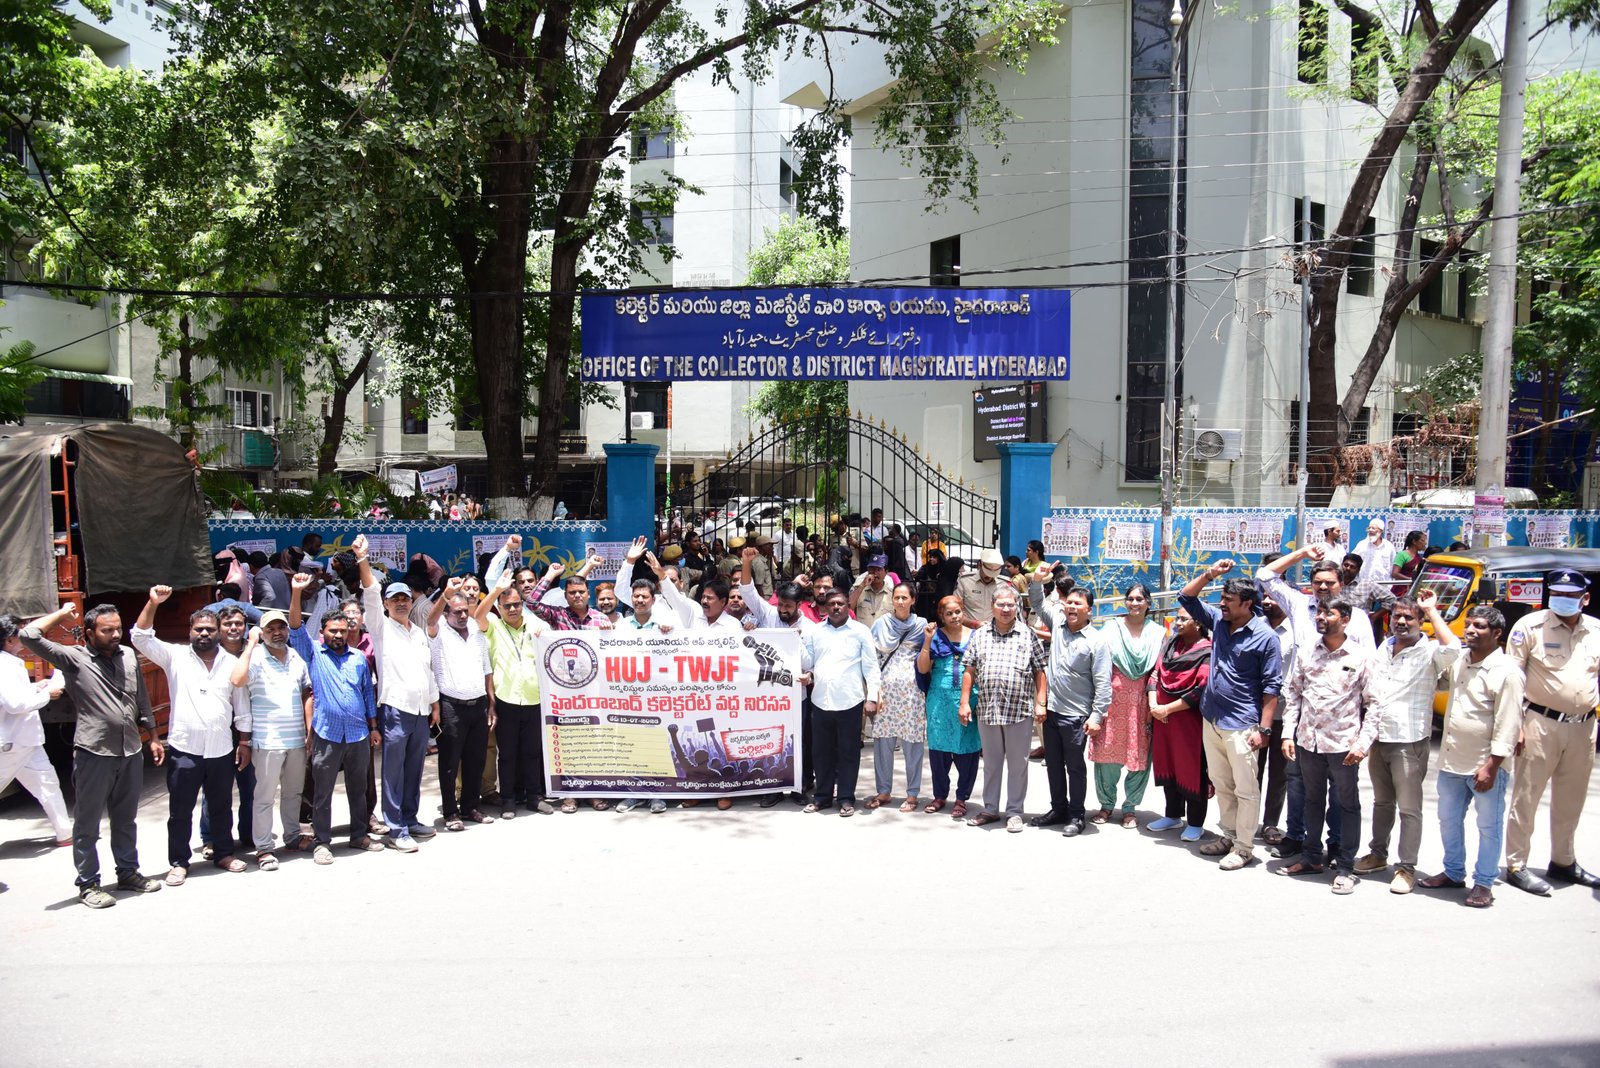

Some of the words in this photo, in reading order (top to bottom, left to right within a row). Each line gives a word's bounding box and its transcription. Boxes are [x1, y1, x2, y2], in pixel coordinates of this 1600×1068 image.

[720, 297, 750, 319] జిల్లా
[814, 298, 844, 315] వారి
[954, 294, 1031, 323] హైదరాబాద్
[582, 356, 636, 378] OFFICE
[640, 356, 660, 377] OF
[664, 356, 694, 377] THE
[698, 356, 787, 378] COLLECTOR
[792, 356, 802, 377] &
[806, 356, 875, 377] DISTRICT
[978, 356, 1067, 378] HYDERABAD
[1003, 402, 1018, 411] District
[1524, 587, 1541, 595] GO
[600, 638, 643, 649] హైదరాబాద్
[646, 638, 690, 646] యూనియన్
[605, 656, 651, 682] HUJ
[674, 656, 740, 682] TWJF
[610, 685, 644, 695] జర్నలిస్టుల
[647, 685, 677, 694] సమస్యల
[680, 685, 714, 693] పరిష్కారం
[550, 694, 642, 716] హైదరాబాద్
[648, 693, 711, 718] కలెక్టరేట్
[716, 695, 739, 718] వద్ద
[744, 696, 790, 711] నిరసన
